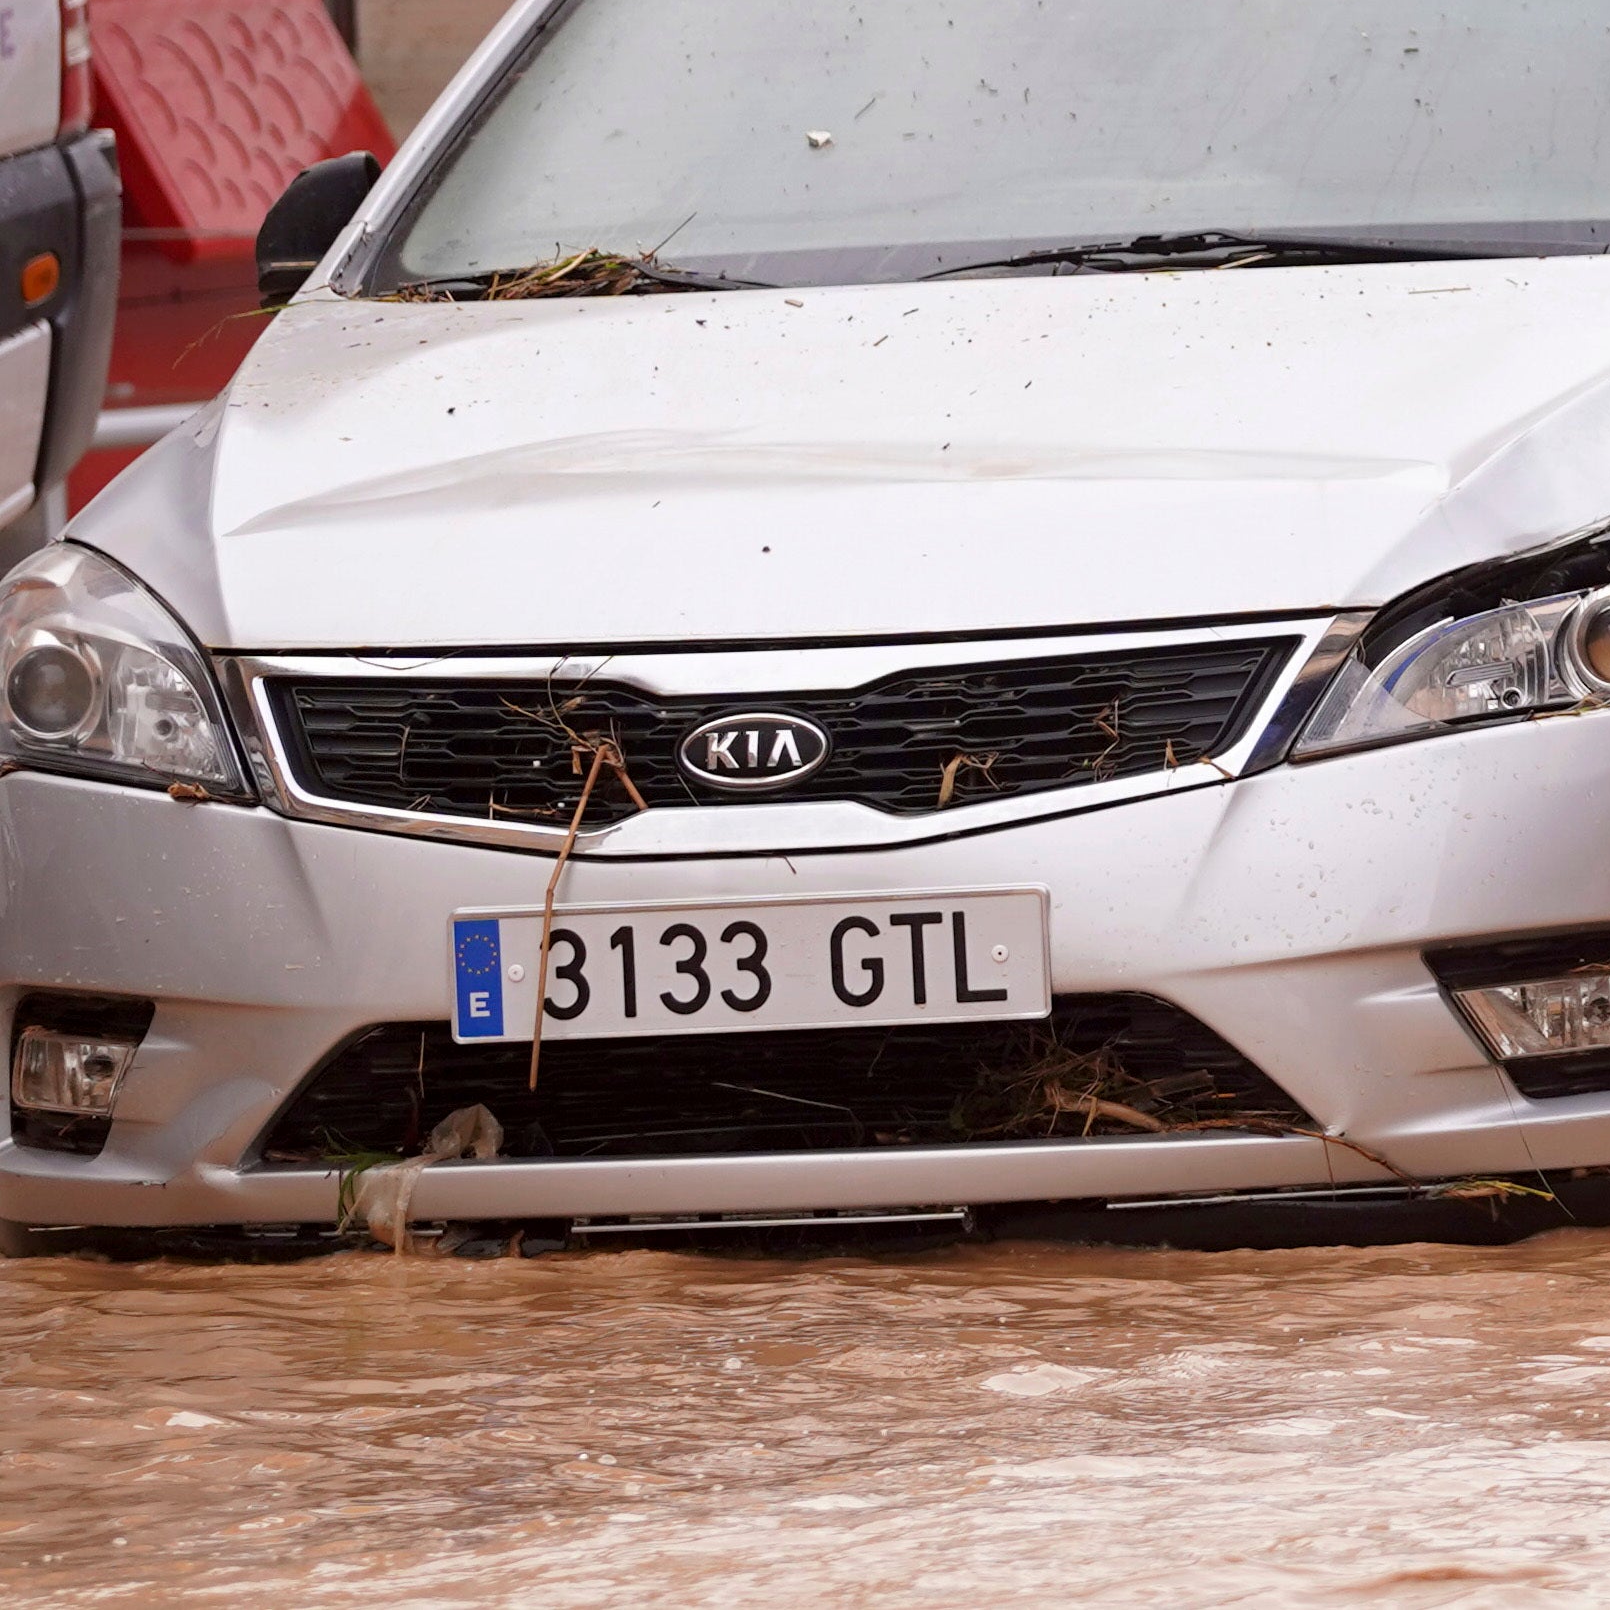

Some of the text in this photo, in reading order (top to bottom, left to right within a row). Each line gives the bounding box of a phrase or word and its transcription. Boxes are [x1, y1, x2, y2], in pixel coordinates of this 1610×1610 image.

[705, 729, 803, 770] KIA
[539, 910, 1008, 1022] 3133 GTL
[469, 991, 491, 1018] E
